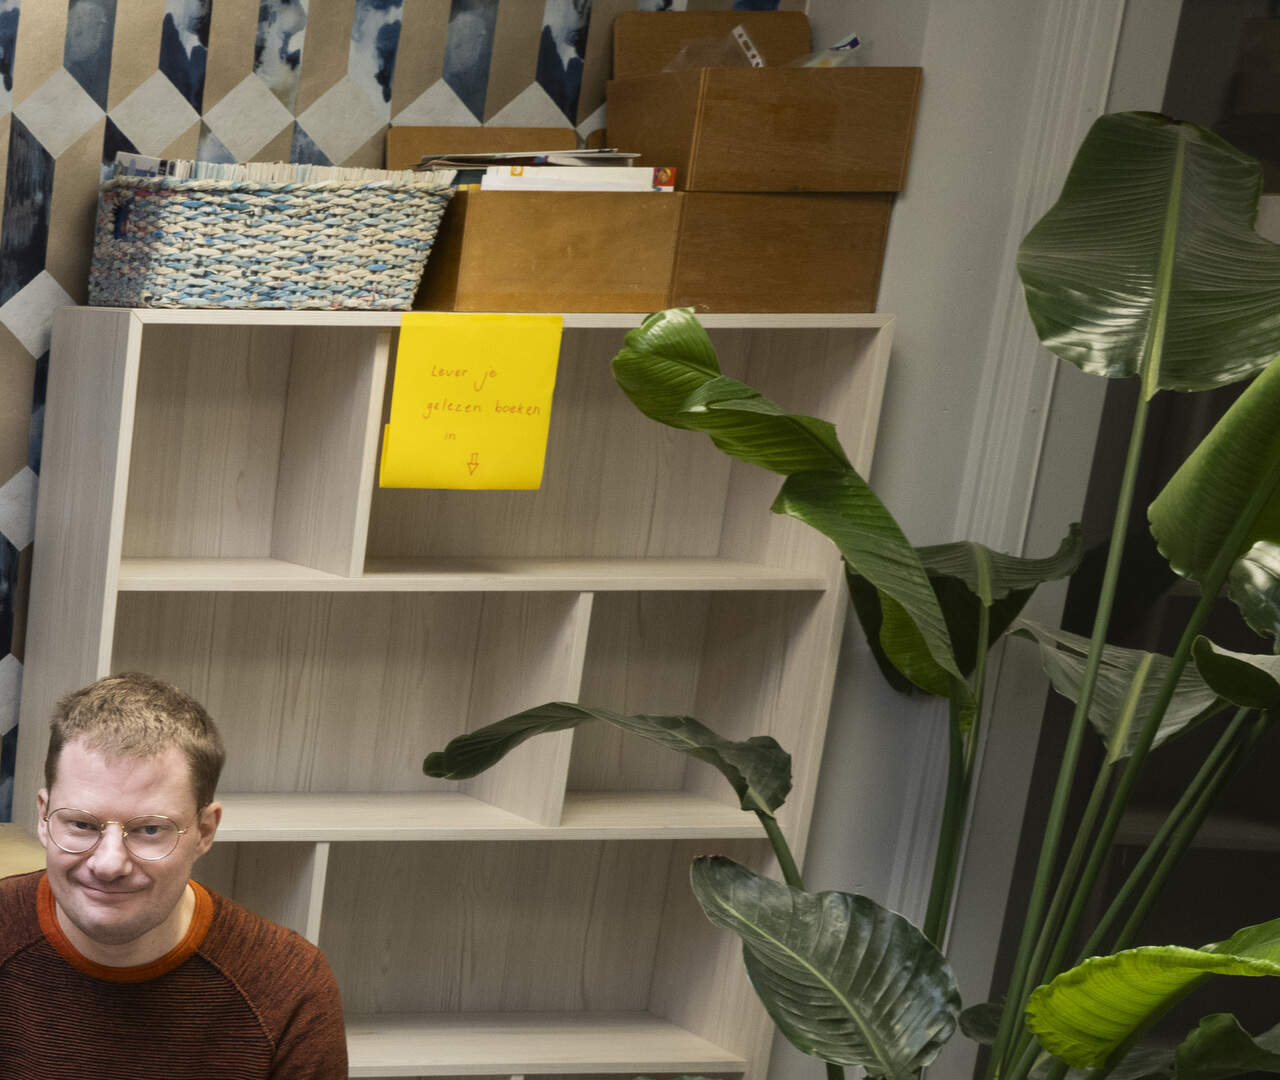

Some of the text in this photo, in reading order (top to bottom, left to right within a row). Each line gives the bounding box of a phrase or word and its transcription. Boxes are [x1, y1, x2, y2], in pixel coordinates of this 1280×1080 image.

[431, 365, 498, 392] Lever je
[422, 398, 541, 419] gelezen boeken
[444, 432, 457, 441] in
